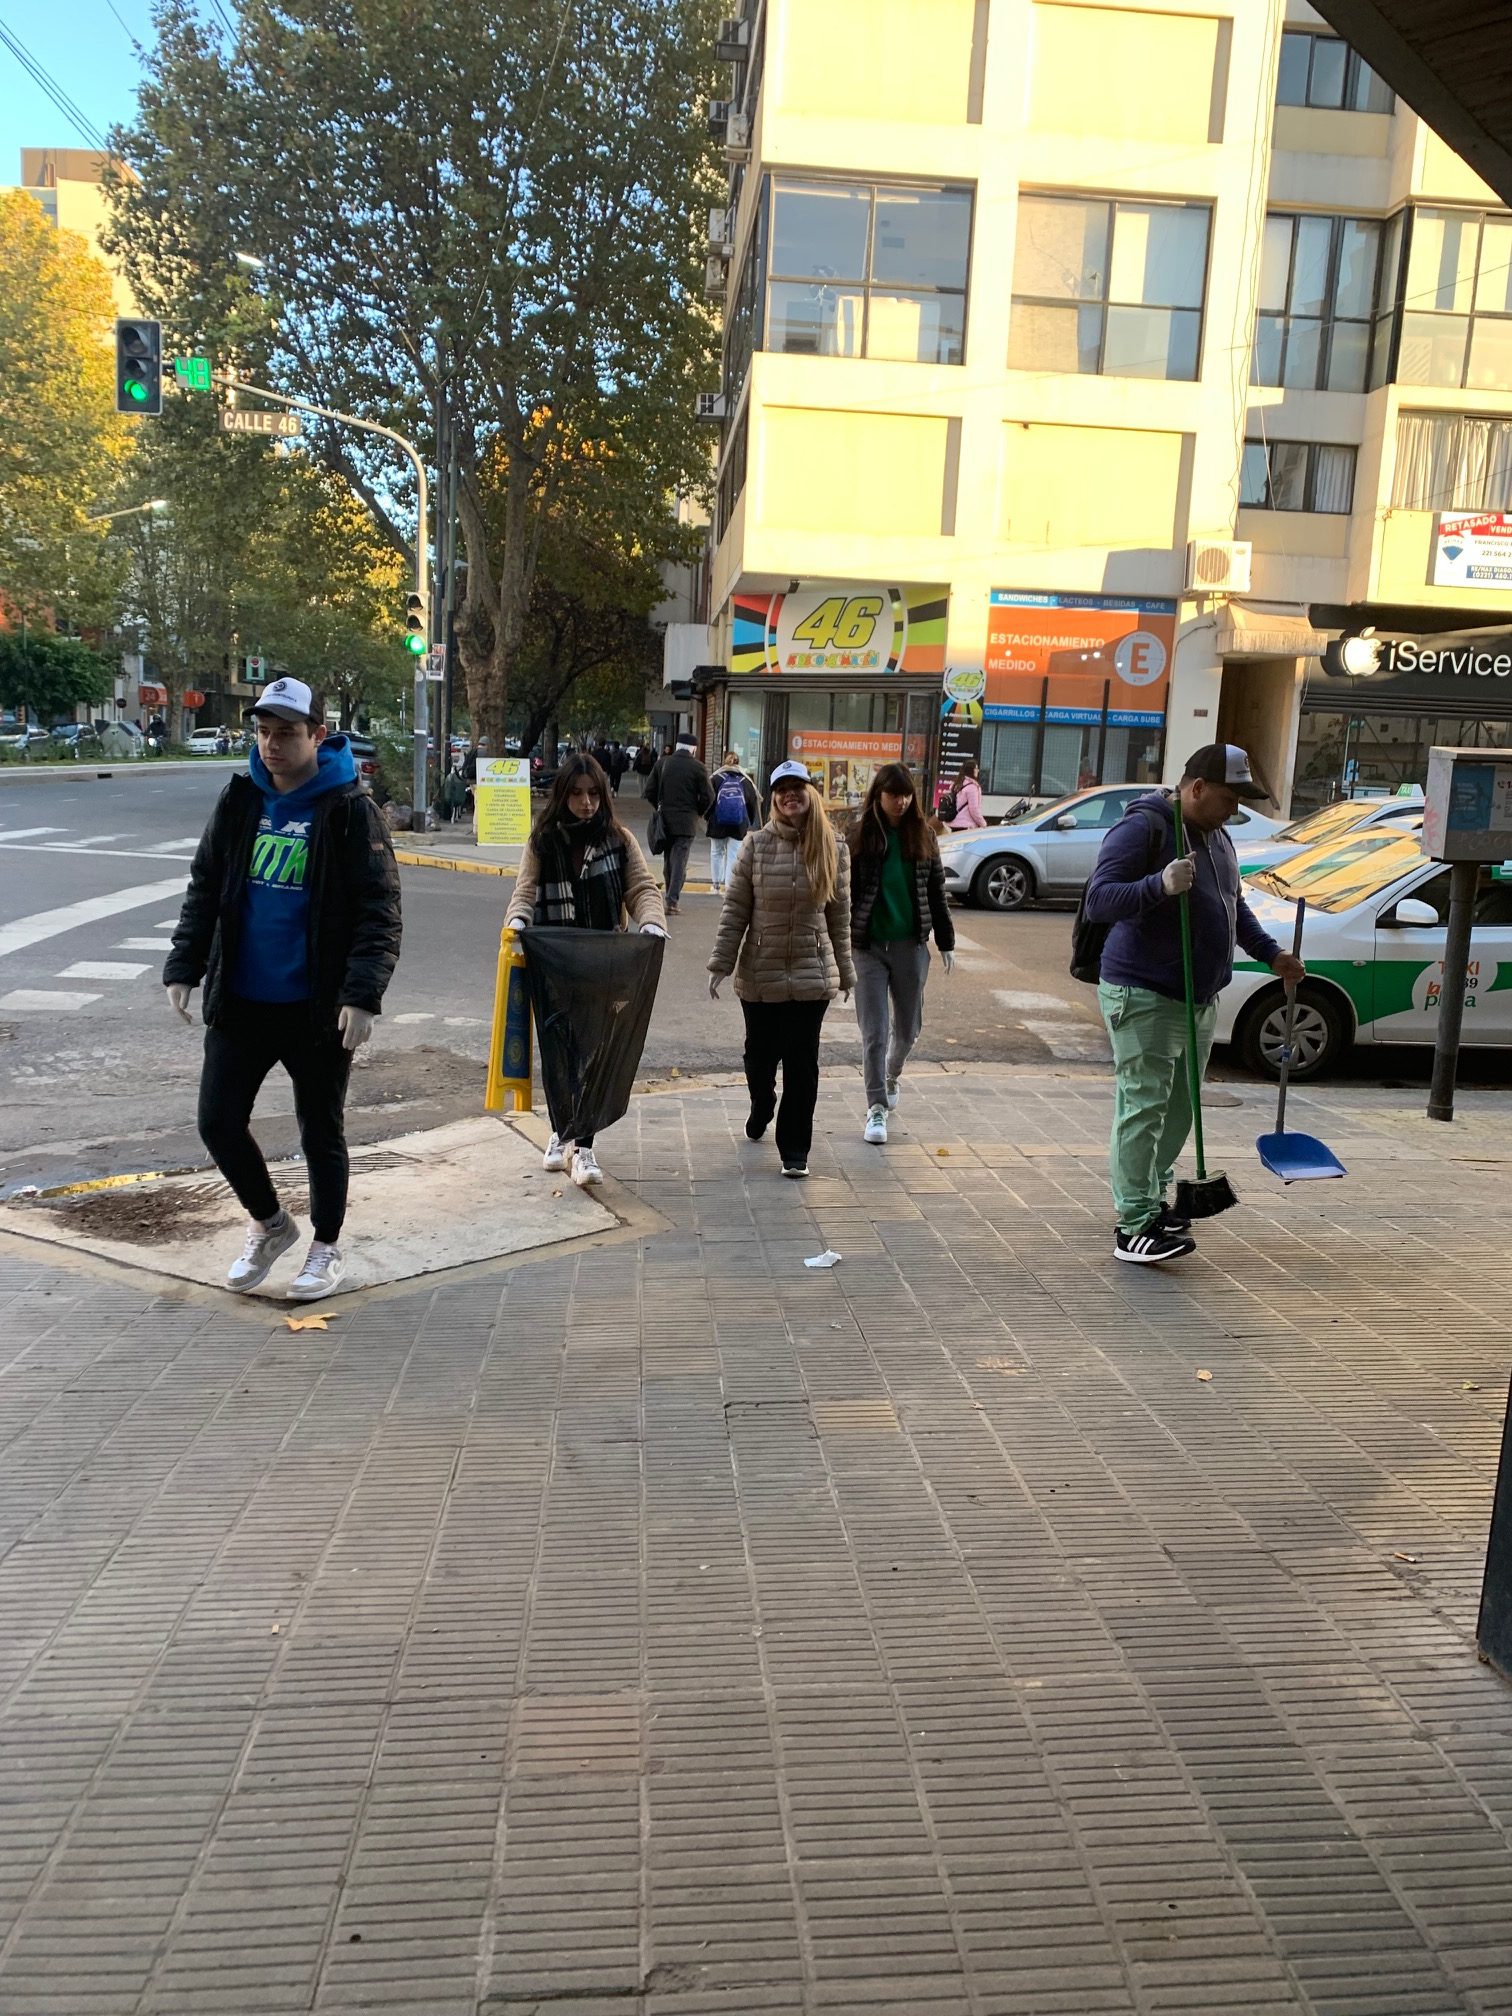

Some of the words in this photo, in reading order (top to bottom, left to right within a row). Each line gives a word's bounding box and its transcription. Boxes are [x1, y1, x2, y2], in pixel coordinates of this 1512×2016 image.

[175, 357, 211, 389] 48
[223, 411, 272, 431] CALLE
[278, 416, 297, 434] 46
[1444, 515, 1497, 533] RETASADO
[998, 593, 1049, 604] SANDWICHES
[792, 596, 884, 649] 46
[990, 632, 1105, 649] ESTACIONAMIENTO
[988, 659, 1036, 672] MEDIDO
[1130, 642, 1151, 675] E
[1389, 640, 1511, 677] iService
[949, 672, 983, 688] 46
[984, 707, 1035, 718] CIGARRILLOS
[1112, 715, 1139, 723] CARGA
[1140, 716, 1161, 724] SUBE
[803, 740, 879, 750] ESTACIONAMIENTO
[881, 743, 915, 752] MEDIO
[486, 759, 520, 775] 46
[1438, 961, 1480, 975] TXI
